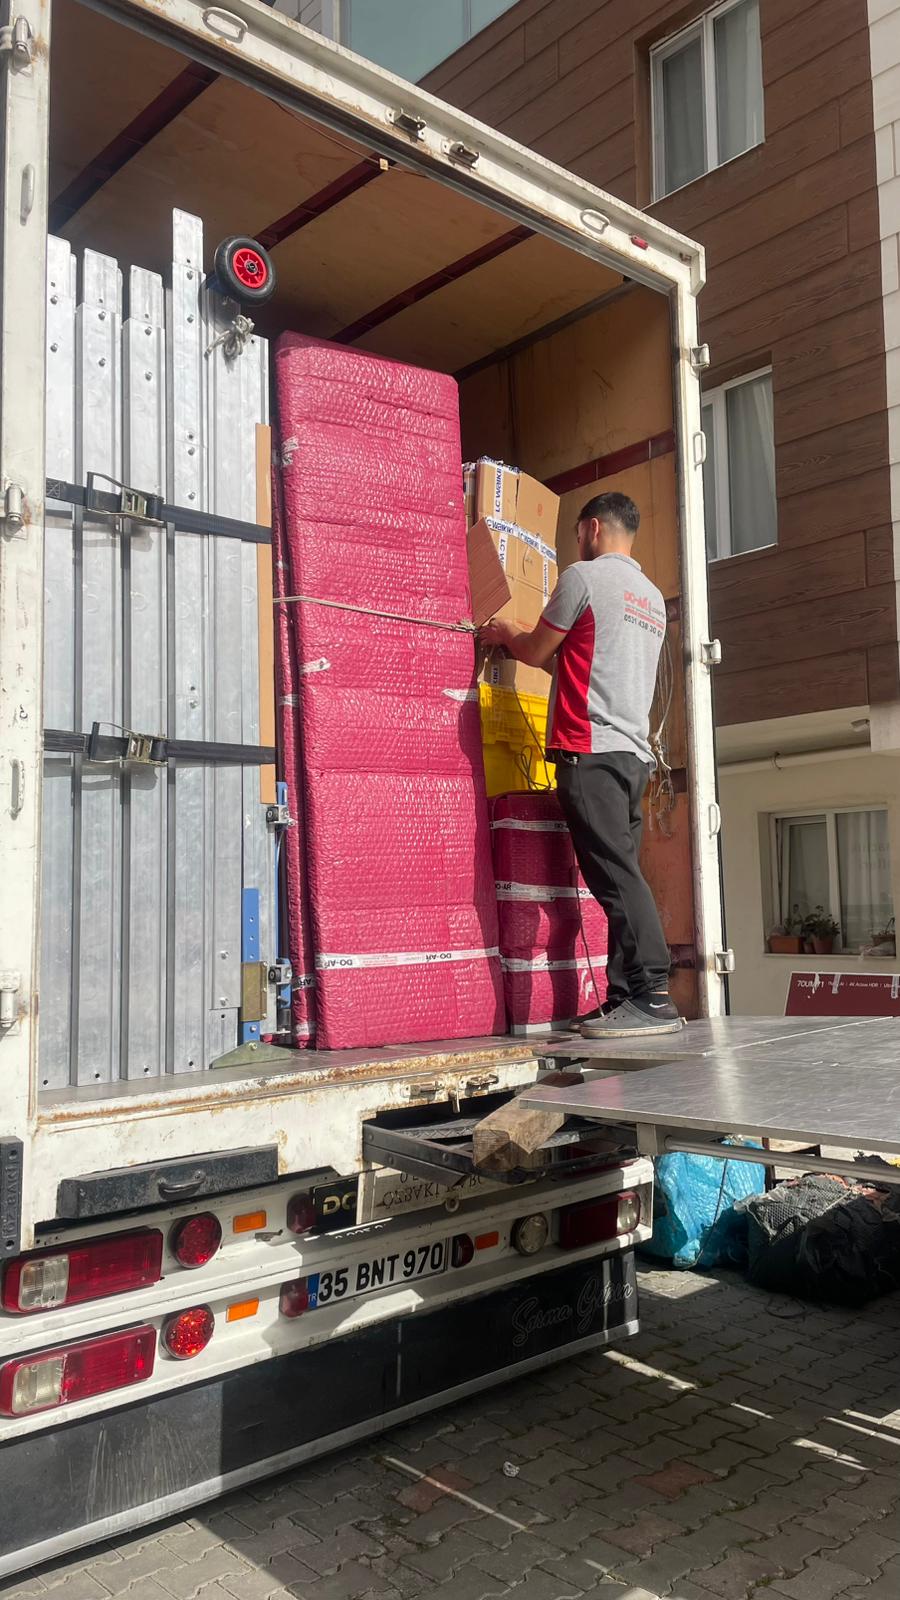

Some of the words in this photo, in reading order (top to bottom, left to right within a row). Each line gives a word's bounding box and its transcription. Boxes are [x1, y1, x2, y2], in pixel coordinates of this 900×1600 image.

[319, 1267, 349, 1302] 35
[356, 1254, 400, 1291] BNT
[403, 1242, 443, 1278] 970
[308, 1293, 317, 1301] TR
